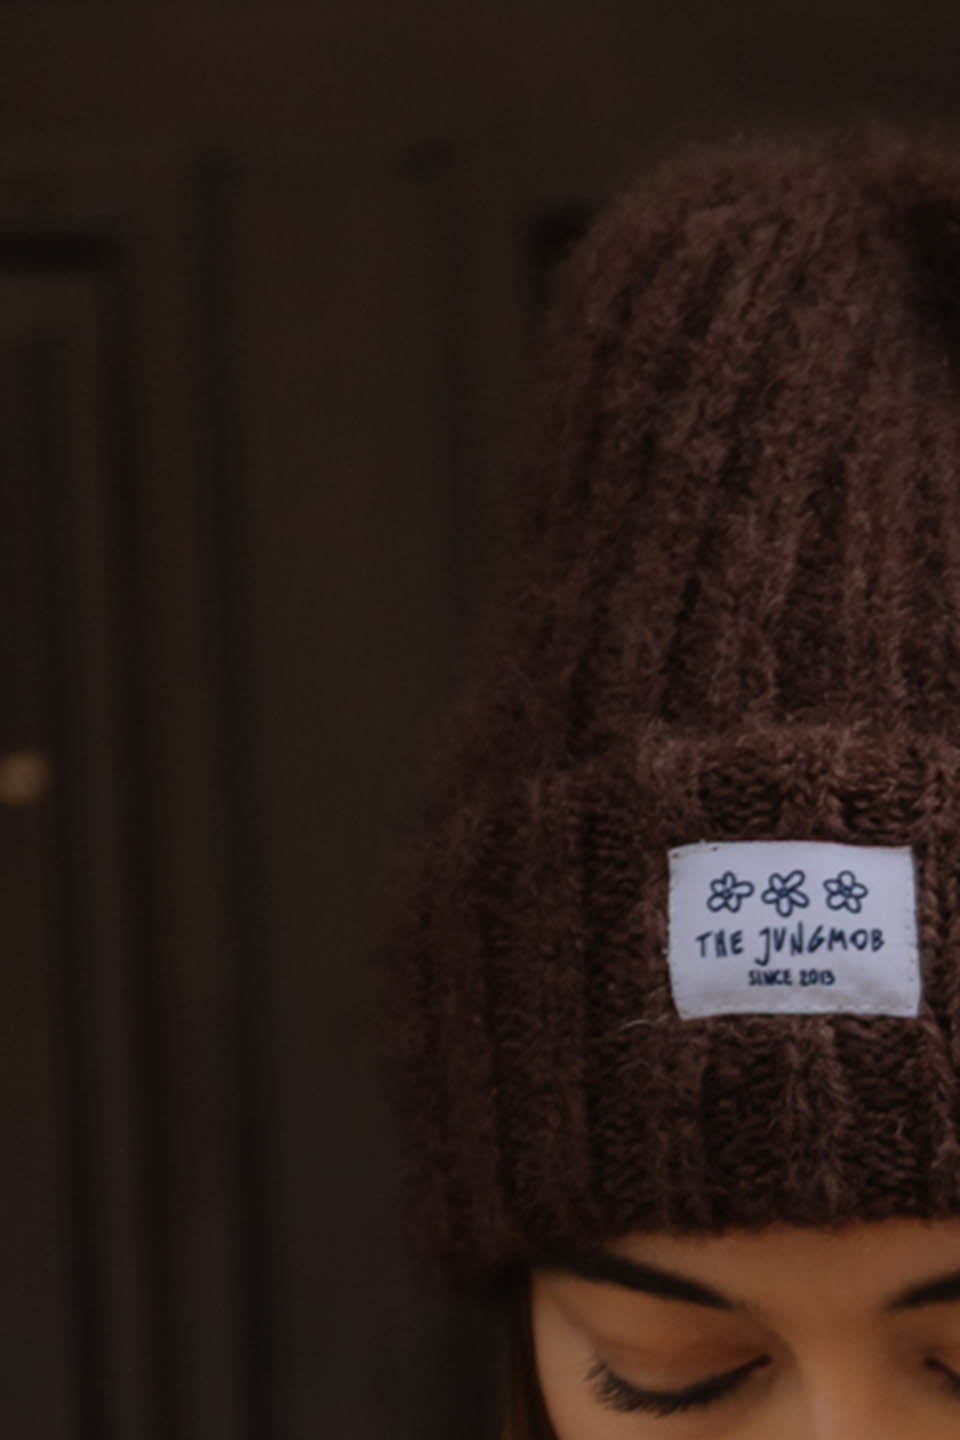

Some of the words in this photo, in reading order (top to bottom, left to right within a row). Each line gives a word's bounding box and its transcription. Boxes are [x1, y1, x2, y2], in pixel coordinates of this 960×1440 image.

[695, 928, 744, 958] THE
[748, 969, 793, 987] SINCE
[799, 969, 836, 987] 2013
